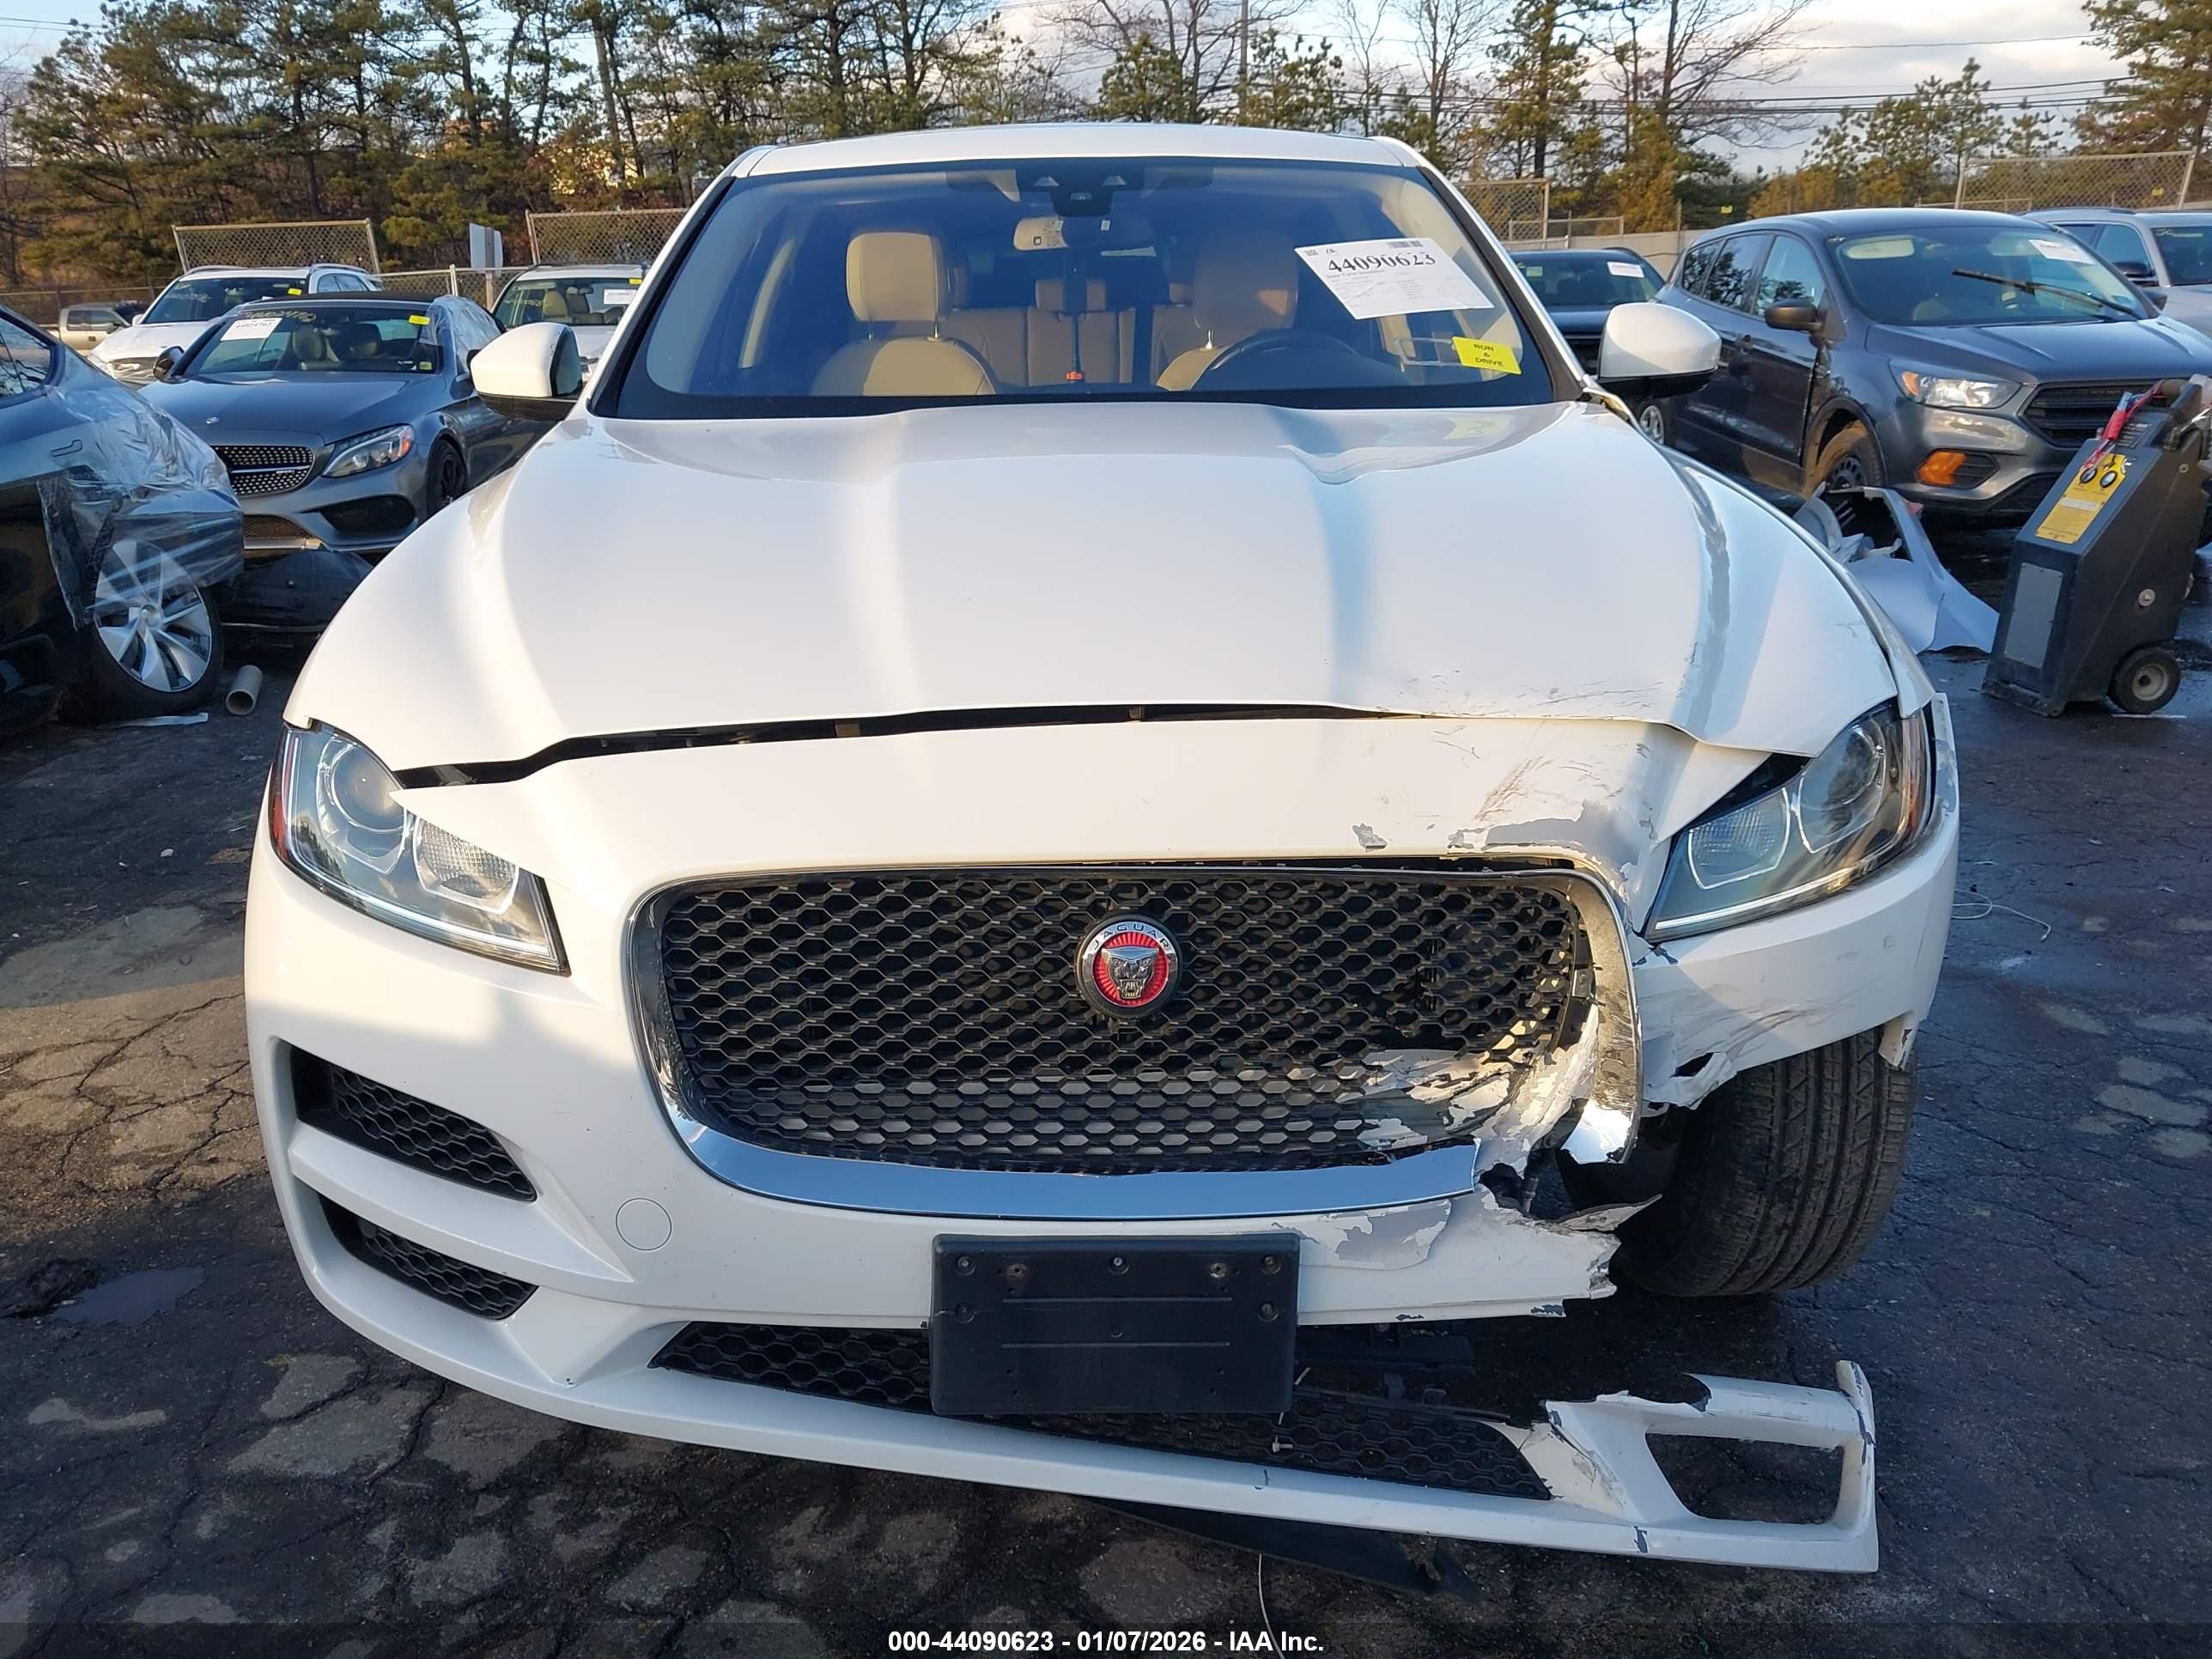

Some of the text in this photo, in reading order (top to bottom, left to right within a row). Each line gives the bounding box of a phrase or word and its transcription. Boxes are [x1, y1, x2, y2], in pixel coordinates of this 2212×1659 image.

[1328, 252, 1437, 273] 44090623
[1475, 357, 1504, 367] DRIVE
[1093, 922, 1171, 951] JAGUAR
